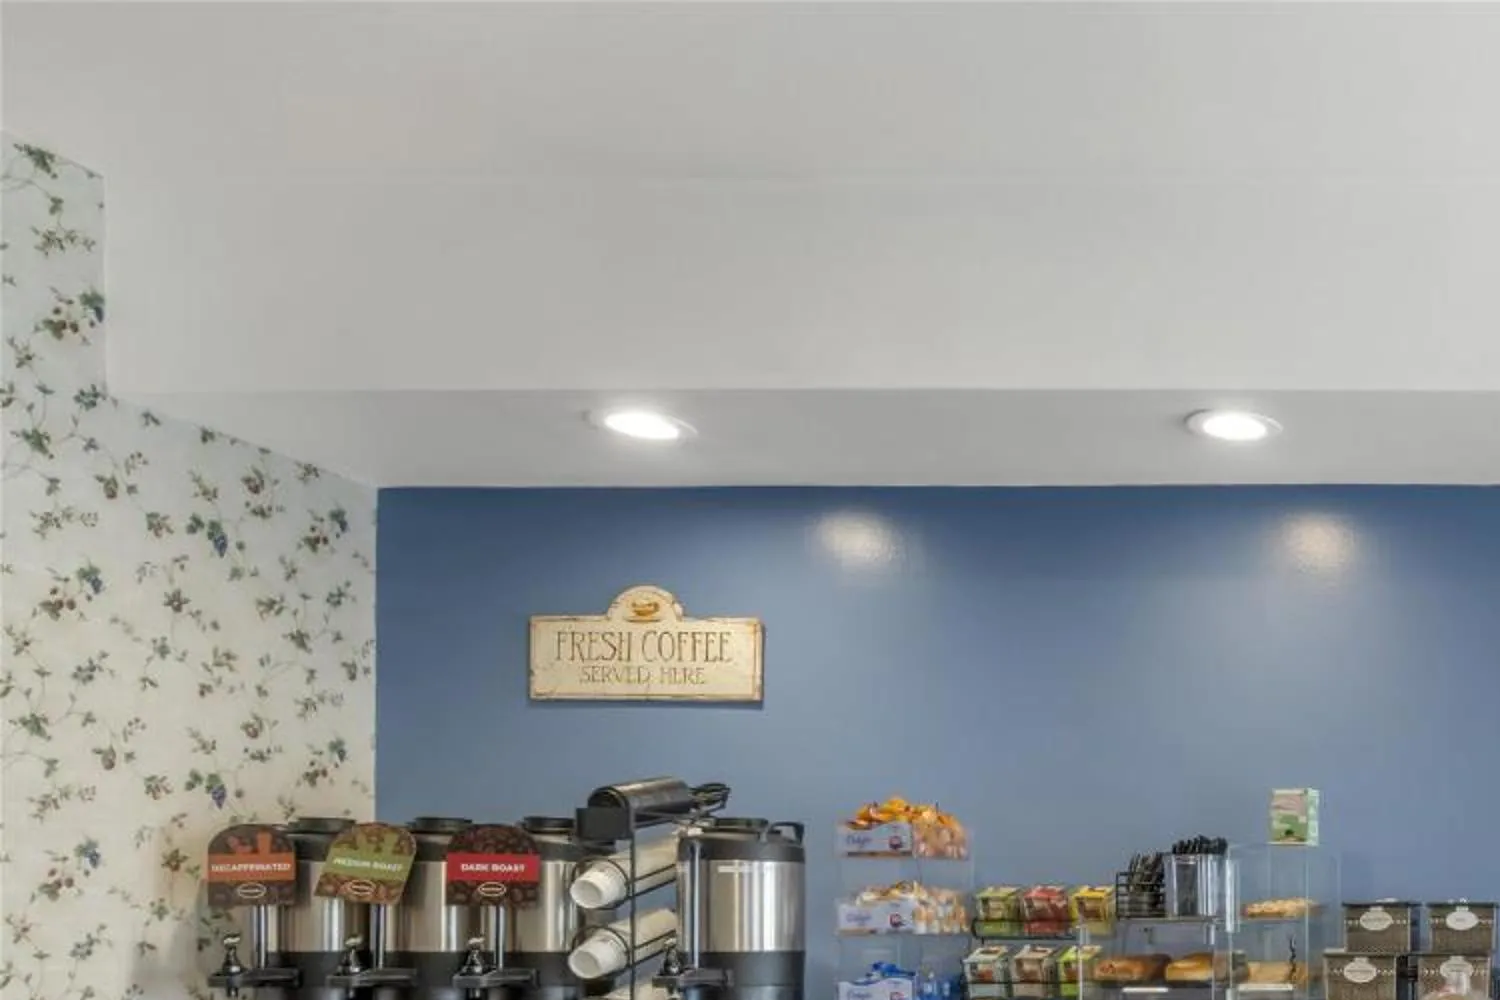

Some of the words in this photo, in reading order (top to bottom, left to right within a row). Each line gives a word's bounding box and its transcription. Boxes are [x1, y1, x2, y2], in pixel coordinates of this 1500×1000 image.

[555, 631, 632, 663] FRESH
[641, 631, 733, 664] COFFEE
[579, 665, 650, 685] SERVED
[659, 666, 705, 685] HERE
[461, 863, 490, 873] DARK
[491, 863, 525, 873] ROAST
